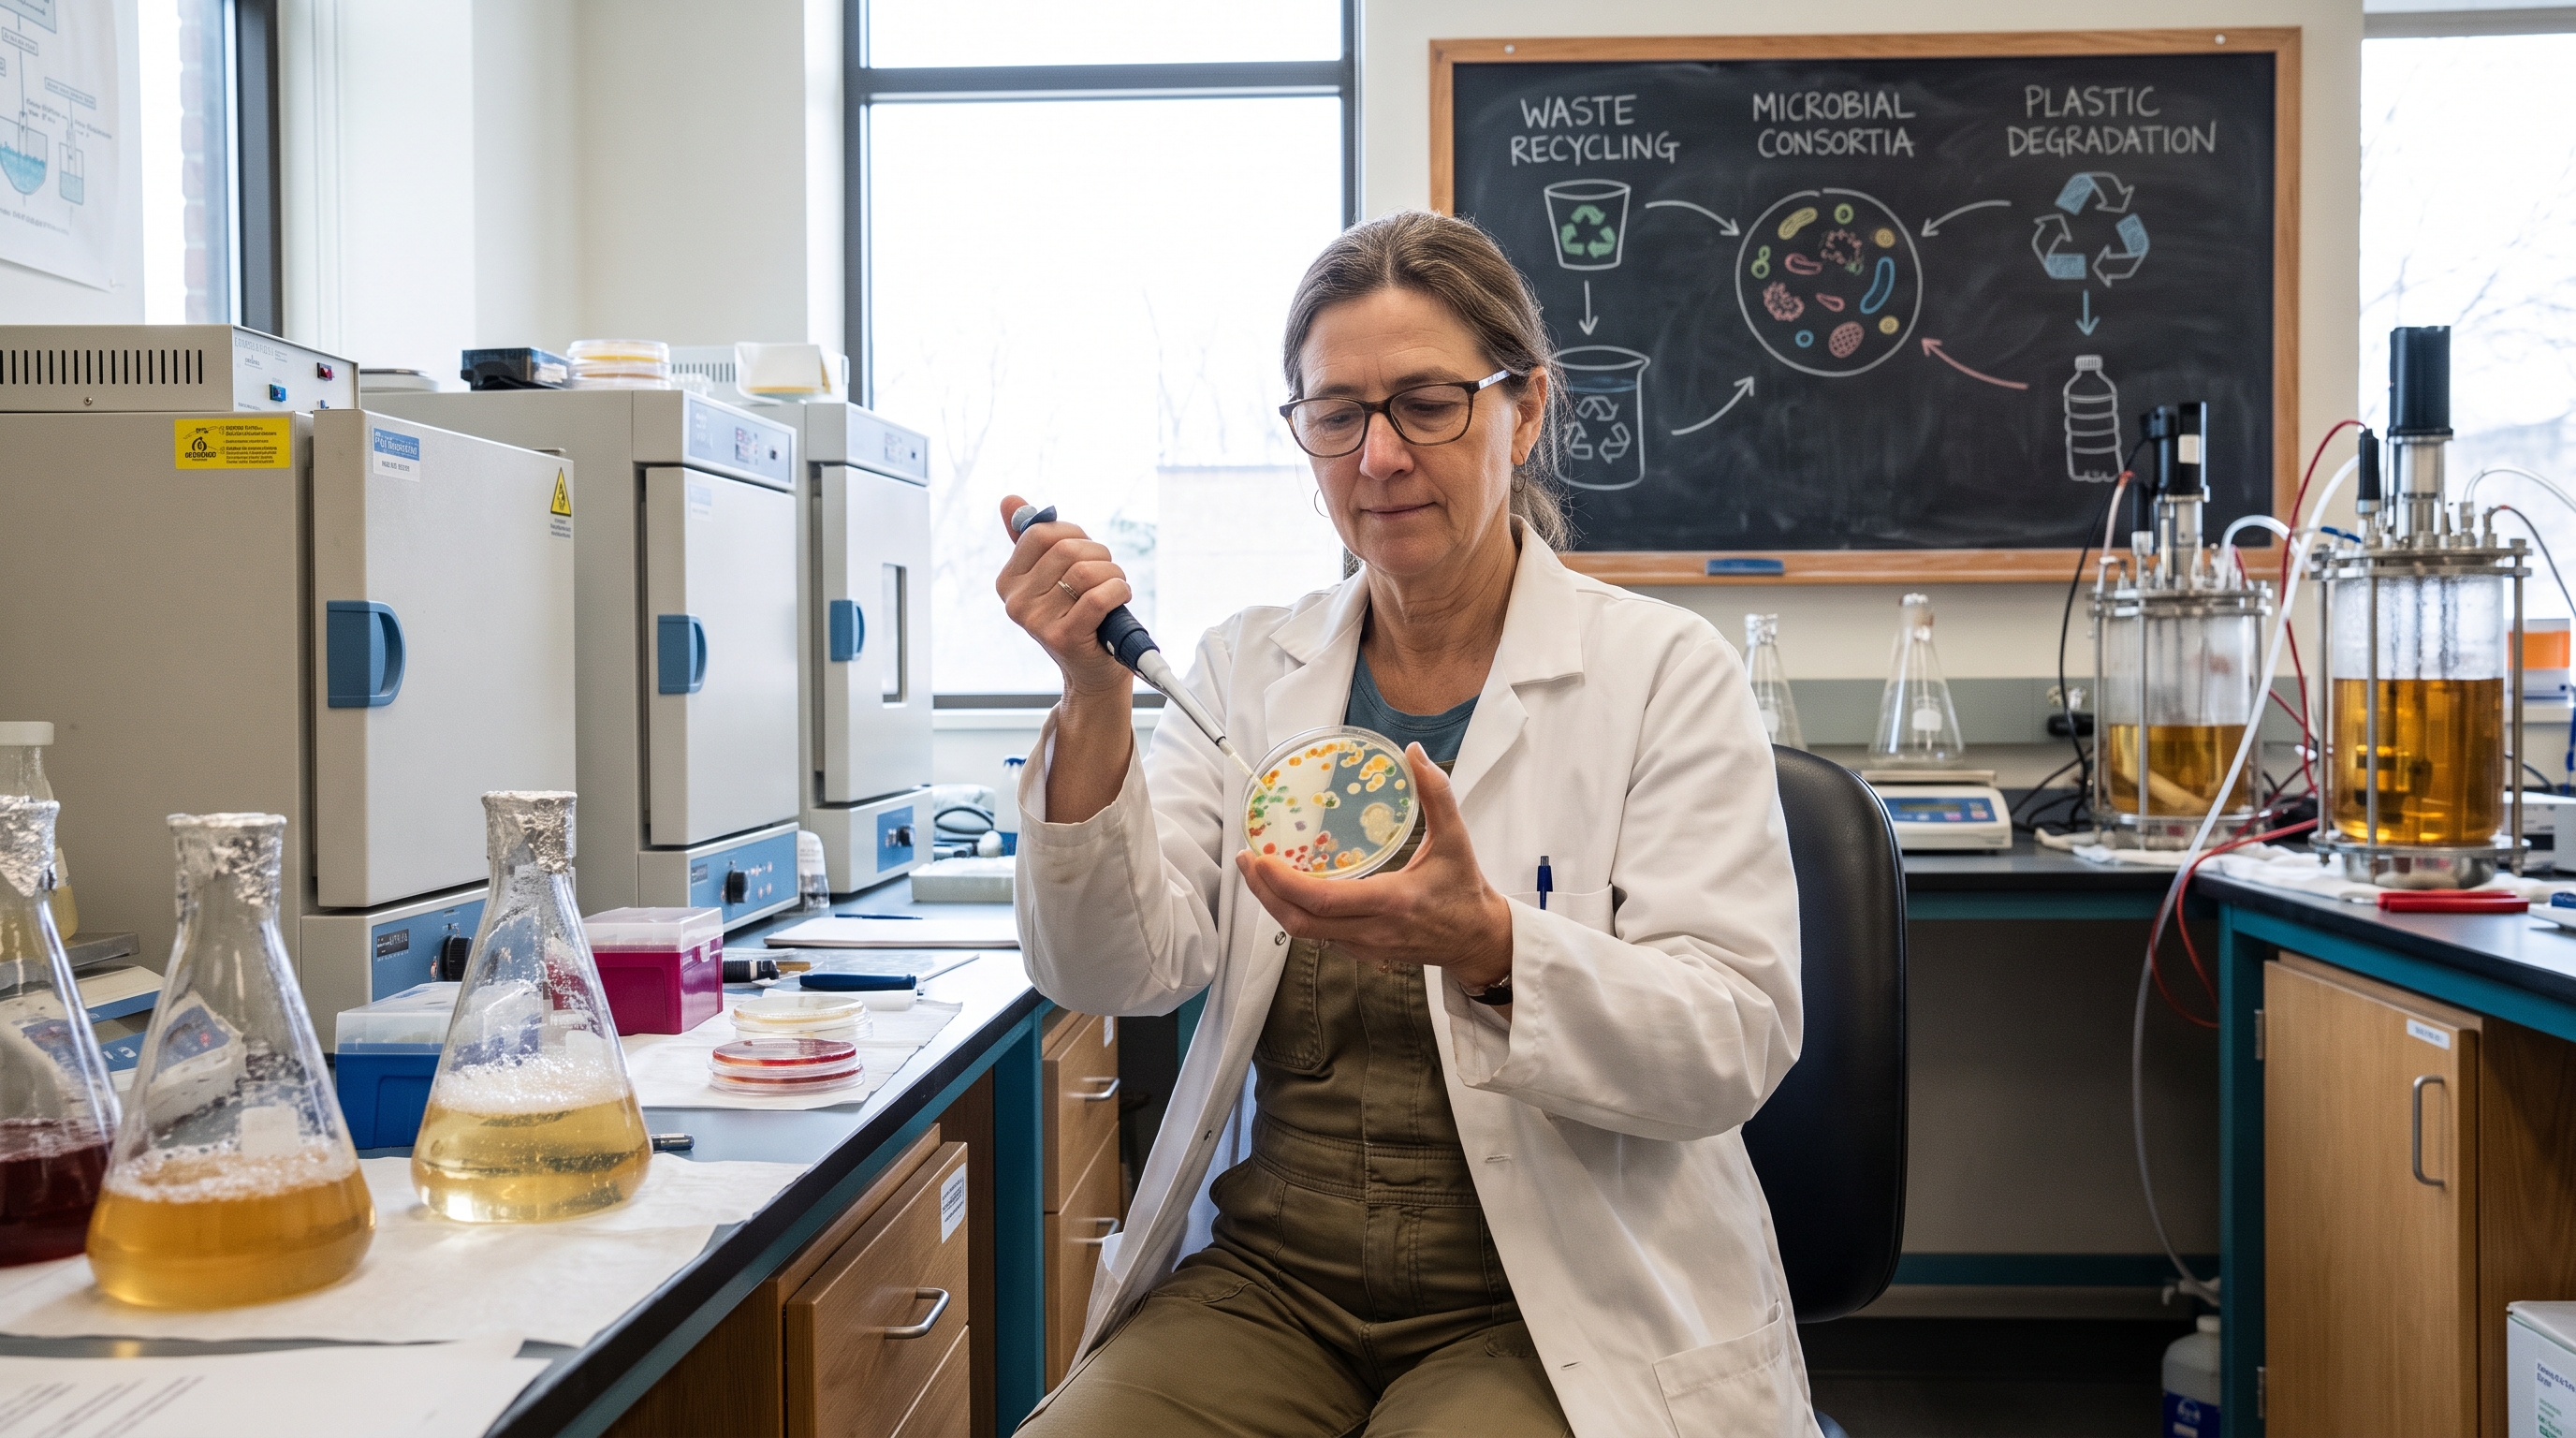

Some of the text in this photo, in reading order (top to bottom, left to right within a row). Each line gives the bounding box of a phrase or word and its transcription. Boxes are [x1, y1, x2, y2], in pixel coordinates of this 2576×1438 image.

[1520, 94, 1637, 129] WASTE
[1752, 90, 1916, 123] MICROBIAL
[2025, 84, 2160, 119] PLASTIC
[1510, 130, 1681, 166] RECYCLING
[1758, 126, 1915, 158] CONSORTIA
[2006, 119, 2217, 158] DEGRADATION
